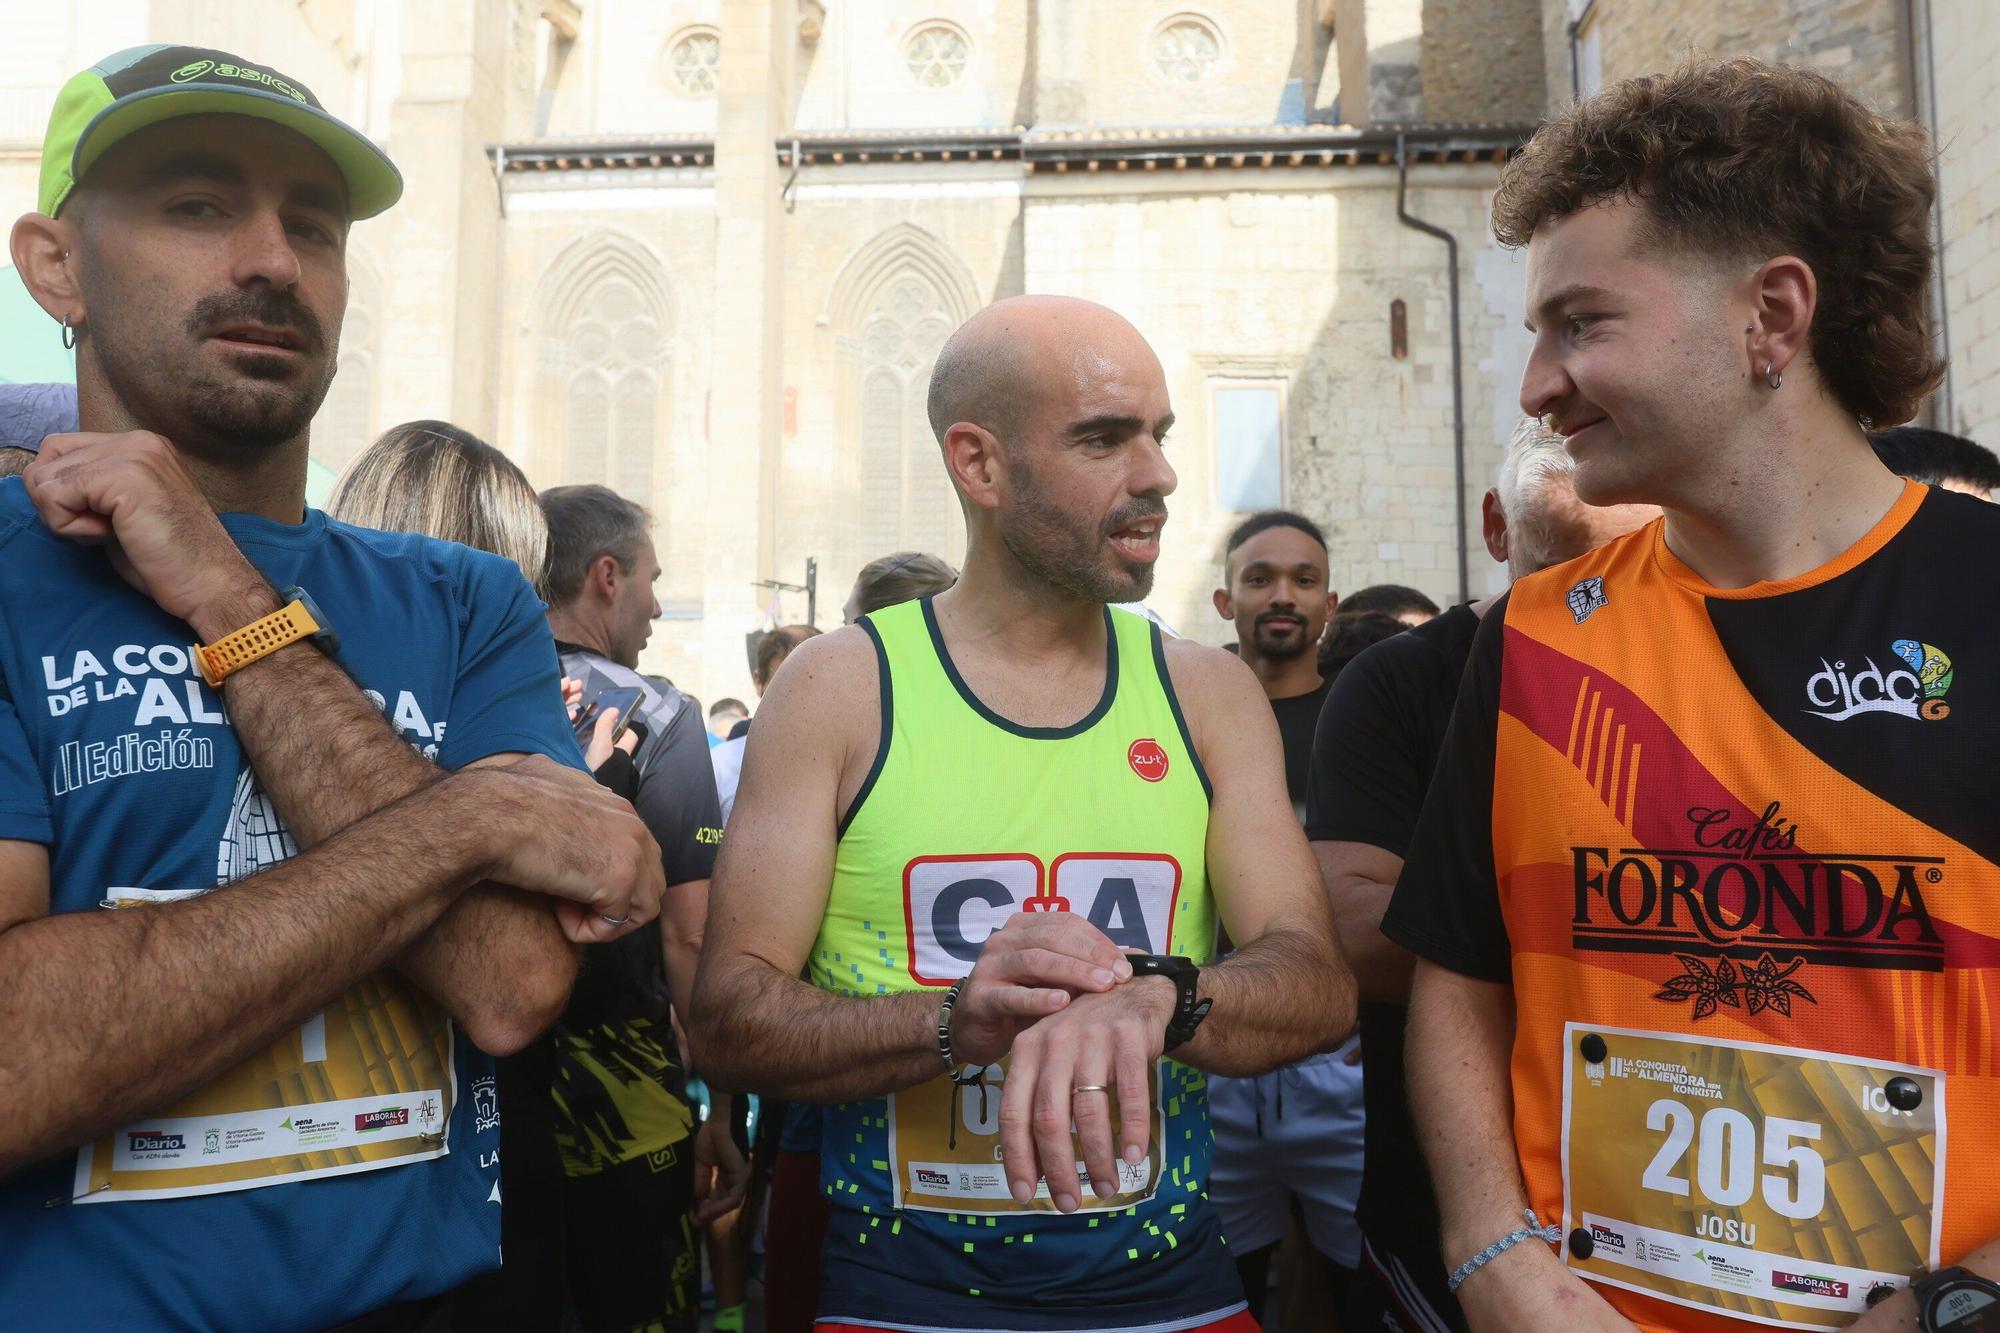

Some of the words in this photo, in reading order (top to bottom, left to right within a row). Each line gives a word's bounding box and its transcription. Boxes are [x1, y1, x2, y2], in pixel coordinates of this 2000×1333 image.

[214, 63, 308, 105] asics
[42, 650, 108, 690] LA
[48, 685, 88, 716] DE
[96, 677, 137, 702] LA
[134, 678, 231, 726] AL
[85, 729, 213, 785] Edición
[1686, 801, 1798, 859] Cafés
[1624, 1059, 1633, 1068] LA
[1635, 1059, 1688, 1074] CONQUISTA
[1637, 1069, 1706, 1088] ALMENDRA
[1672, 1084, 1723, 1100] KONKISTA
[294, 1118, 313, 1127] aena
[364, 1111, 398, 1123] LABORAL
[134, 1136, 180, 1150] Diario
[480, 1149, 500, 1169] LA
[1642, 1098, 1825, 1220] 205
[920, 1173, 946, 1184] Diario
[1594, 1229, 1622, 1247] Diario
[1696, 1214, 1756, 1246] JOSU
[1707, 1254, 1726, 1263] aena
[1784, 1274, 1830, 1289] LABORAL
[1811, 1287, 1830, 1295] kutxa
